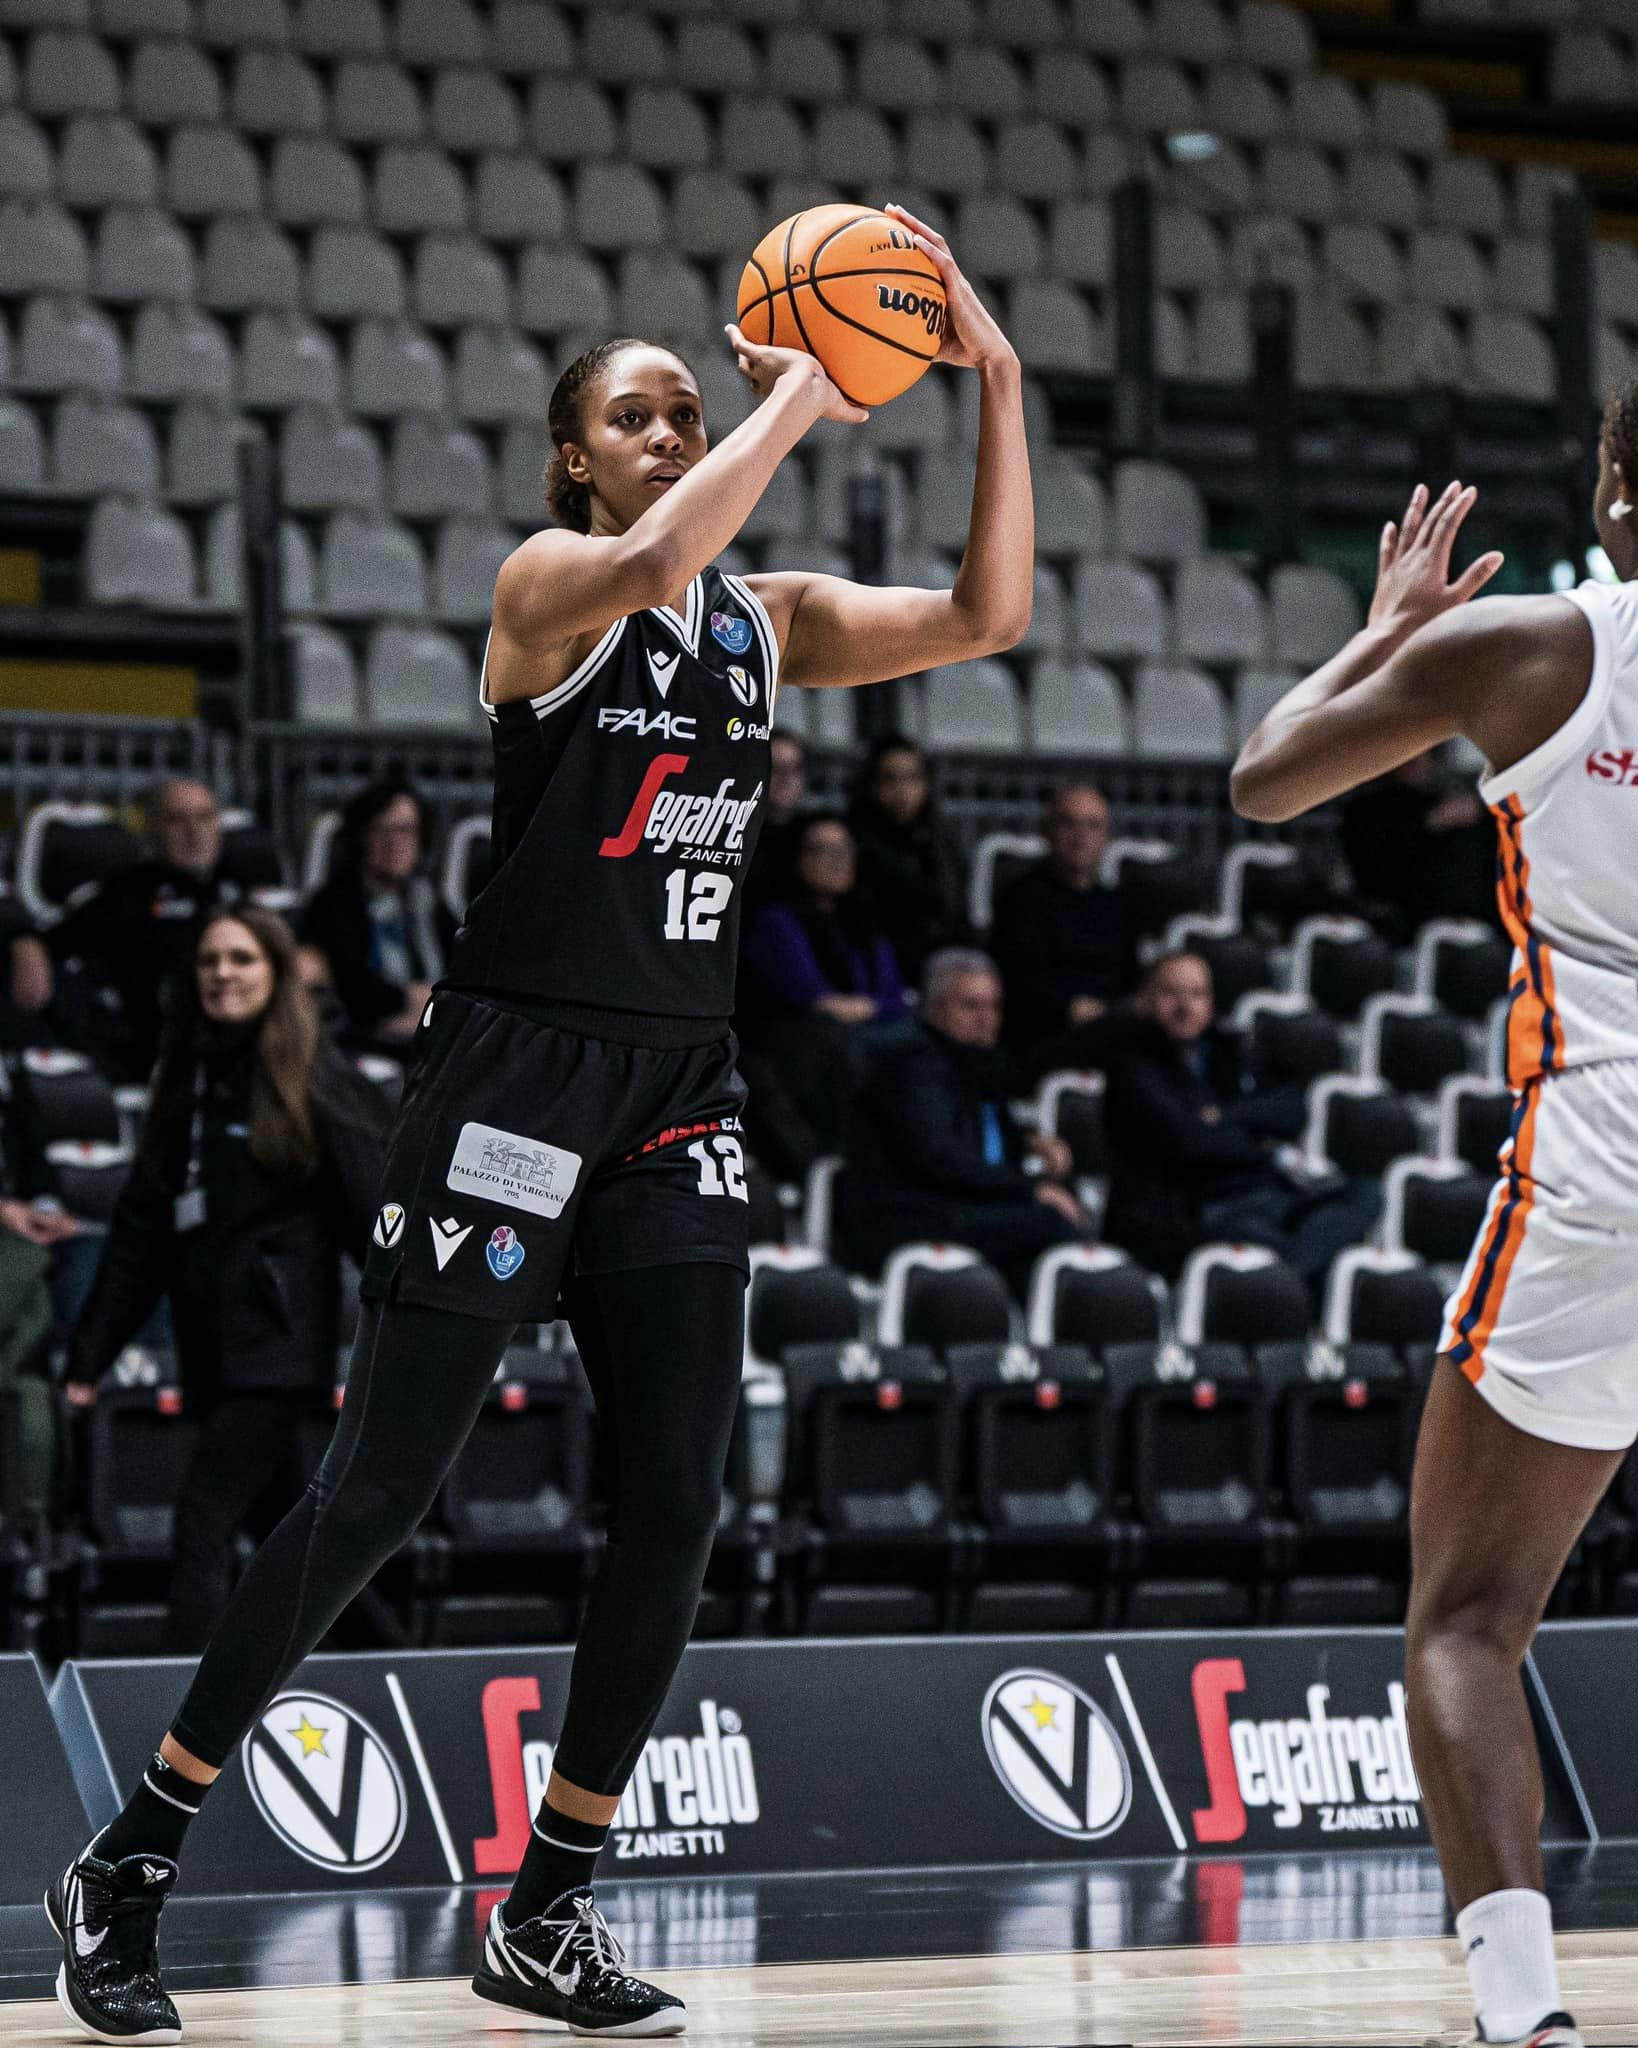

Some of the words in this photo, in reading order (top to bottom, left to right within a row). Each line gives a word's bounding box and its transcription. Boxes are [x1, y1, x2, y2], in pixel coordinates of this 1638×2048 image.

[598, 708, 697, 740] FAAC
[664, 868, 734, 942] 12
[453, 1165, 500, 1184] PALAZZO
[502, 1179, 514, 1188] DI
[687, 1134, 749, 1204] 12
[473, 1676, 760, 1874] Seredo
[1191, 1658, 1423, 1842] Segafred
[1320, 1804, 1418, 1832] ZANETTI
[615, 1830, 725, 1859] ZANETTI
